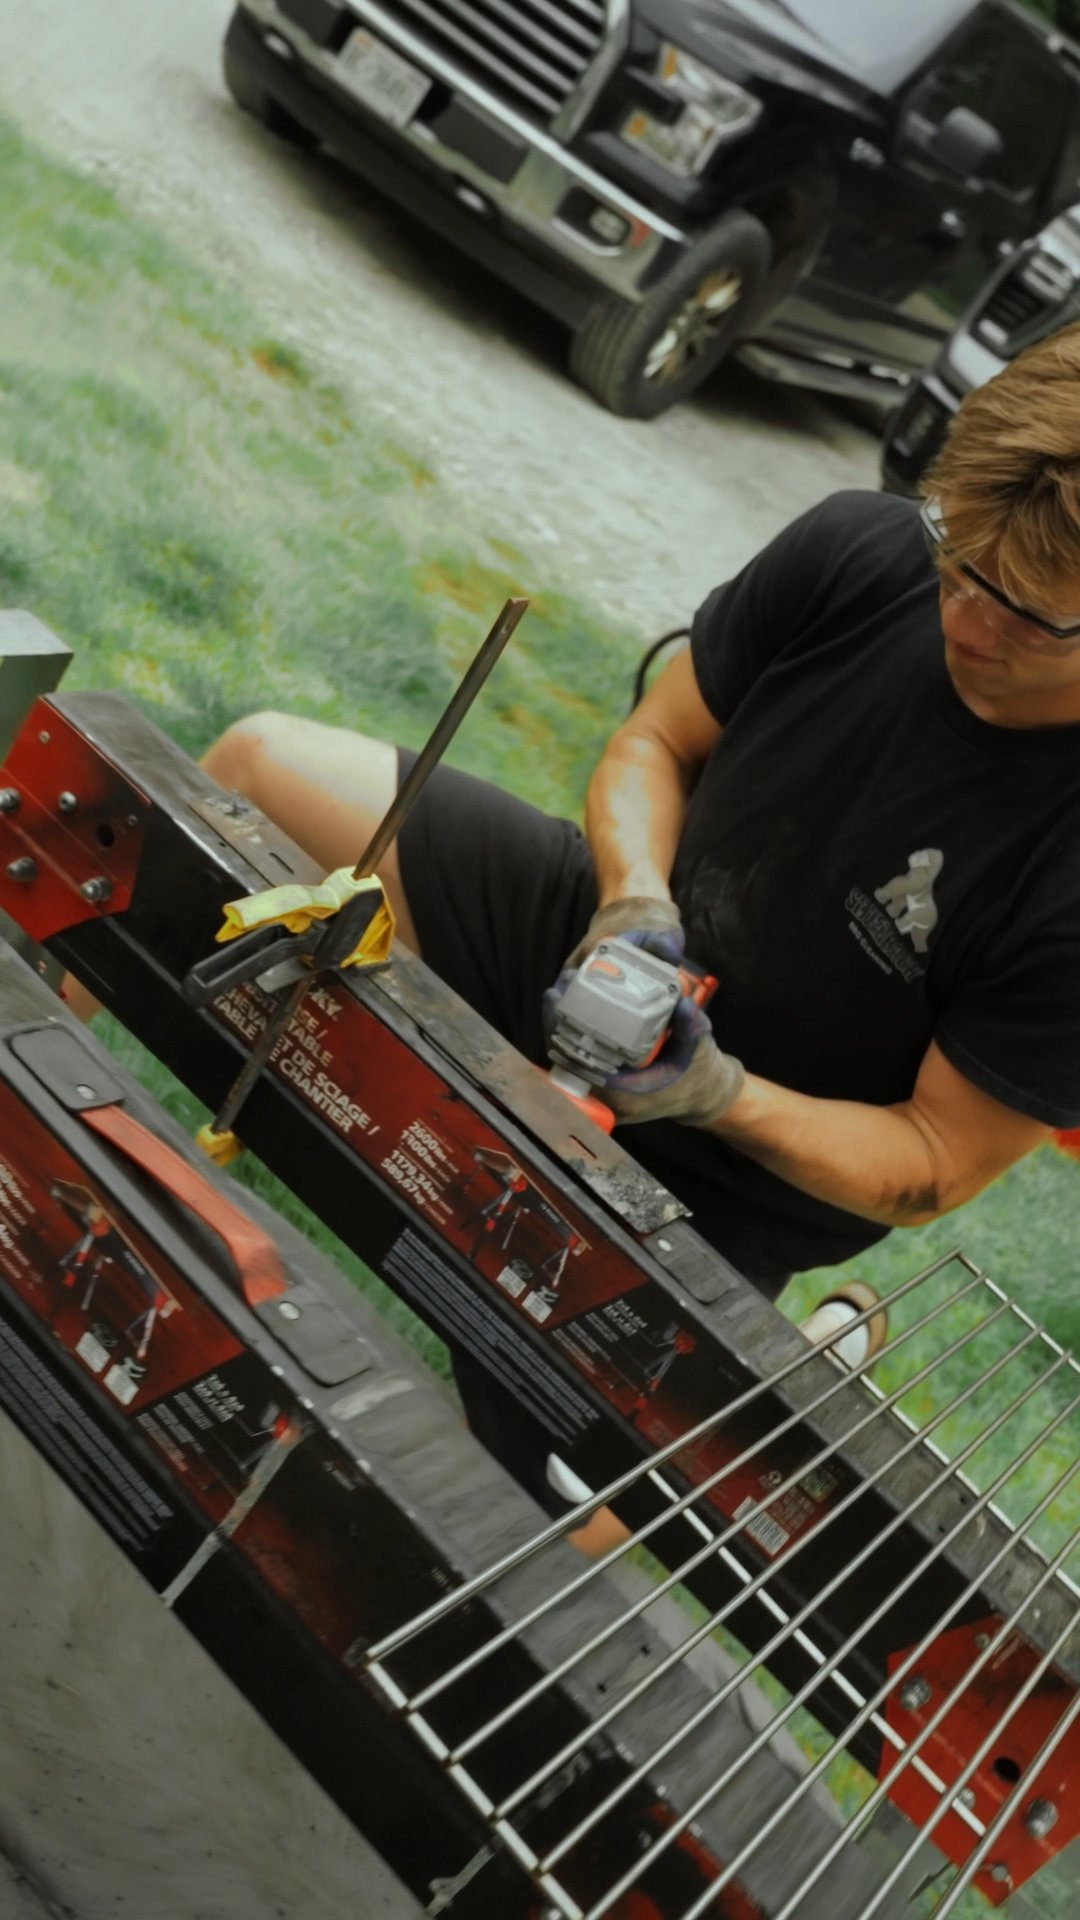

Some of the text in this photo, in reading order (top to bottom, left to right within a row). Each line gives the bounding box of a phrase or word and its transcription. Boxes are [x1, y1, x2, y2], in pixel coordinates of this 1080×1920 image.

[287, 1018, 334, 1067] TABLE
[279, 1058, 353, 1133] CHANTIER
[291, 1049, 316, 1076] DE
[314, 1072, 371, 1130] SCIAGE
